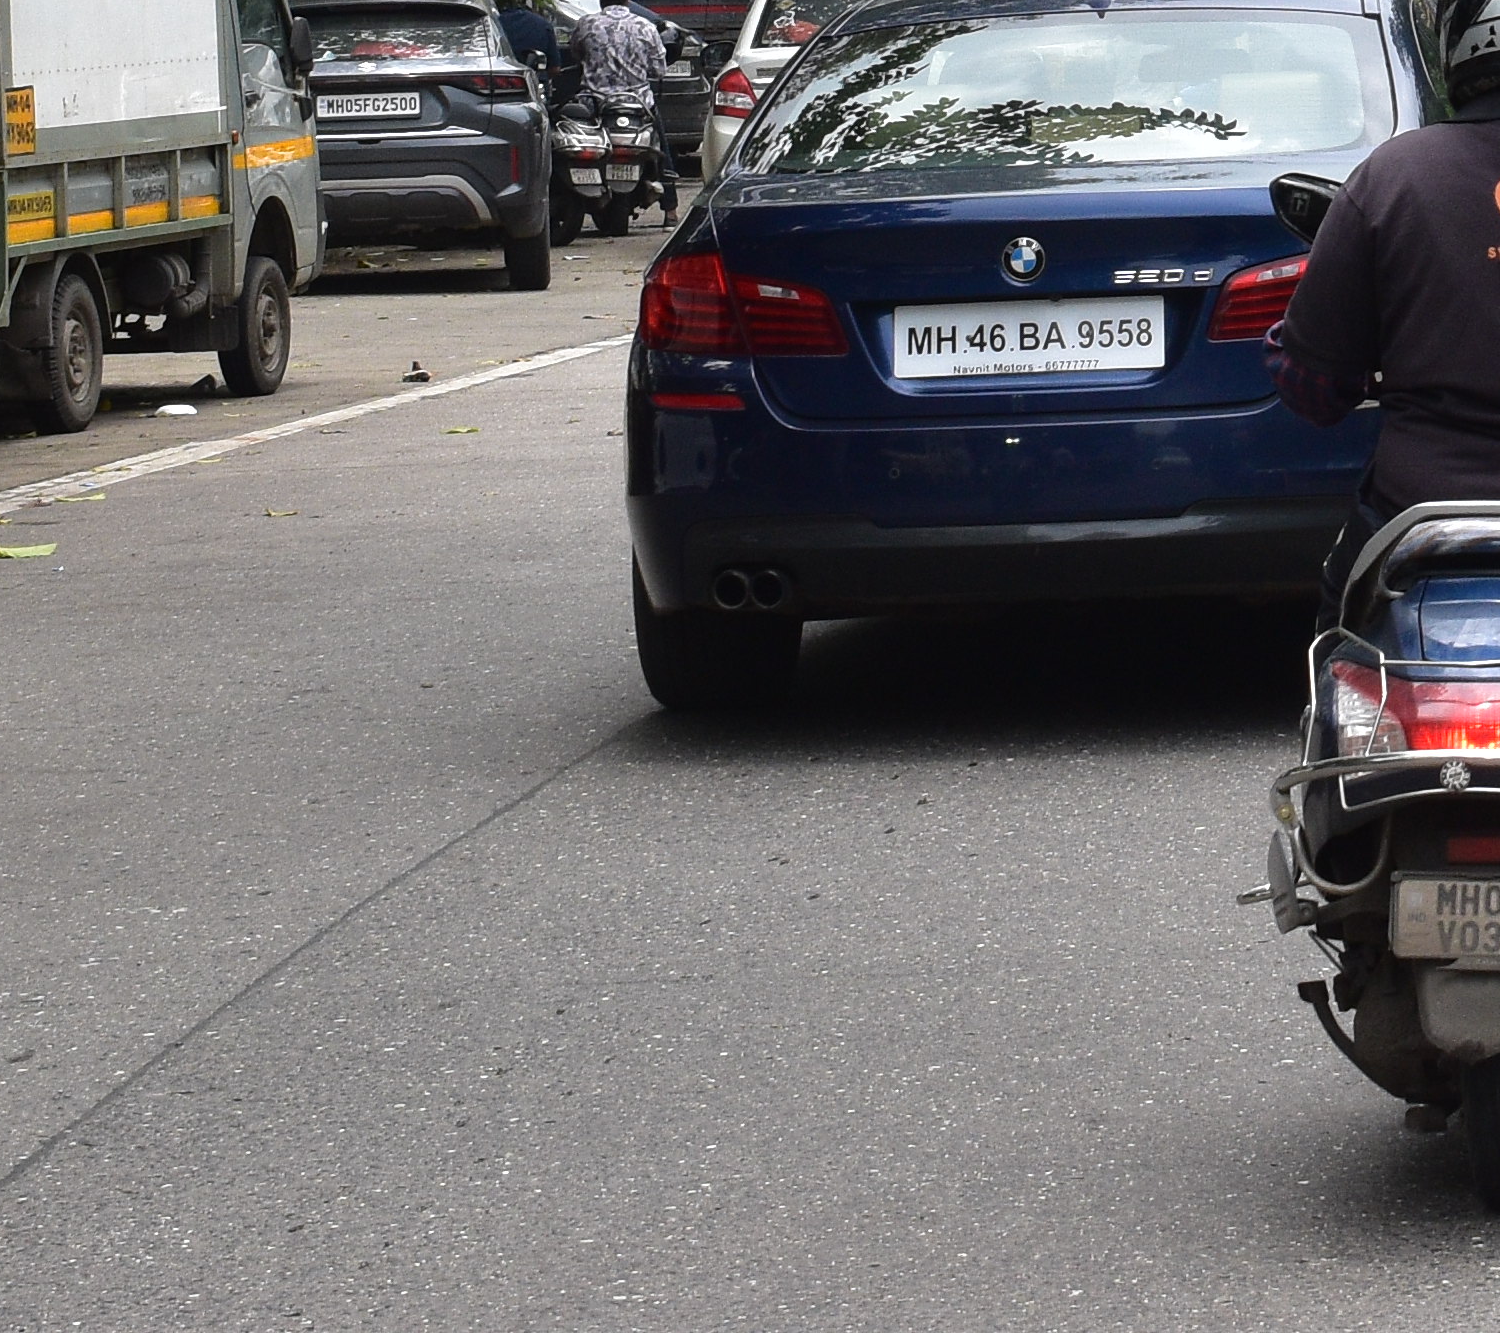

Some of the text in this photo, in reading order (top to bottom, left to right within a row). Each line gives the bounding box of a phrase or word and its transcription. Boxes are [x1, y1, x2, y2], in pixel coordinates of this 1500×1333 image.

[326, 96, 417, 114] MH05FG2500
[1113, 268, 1214, 284] 520 d
[953, 363, 991, 374] Navnit
[994, 361, 1034, 373] Motors
[1044, 359, 1100, 371] 66777777
